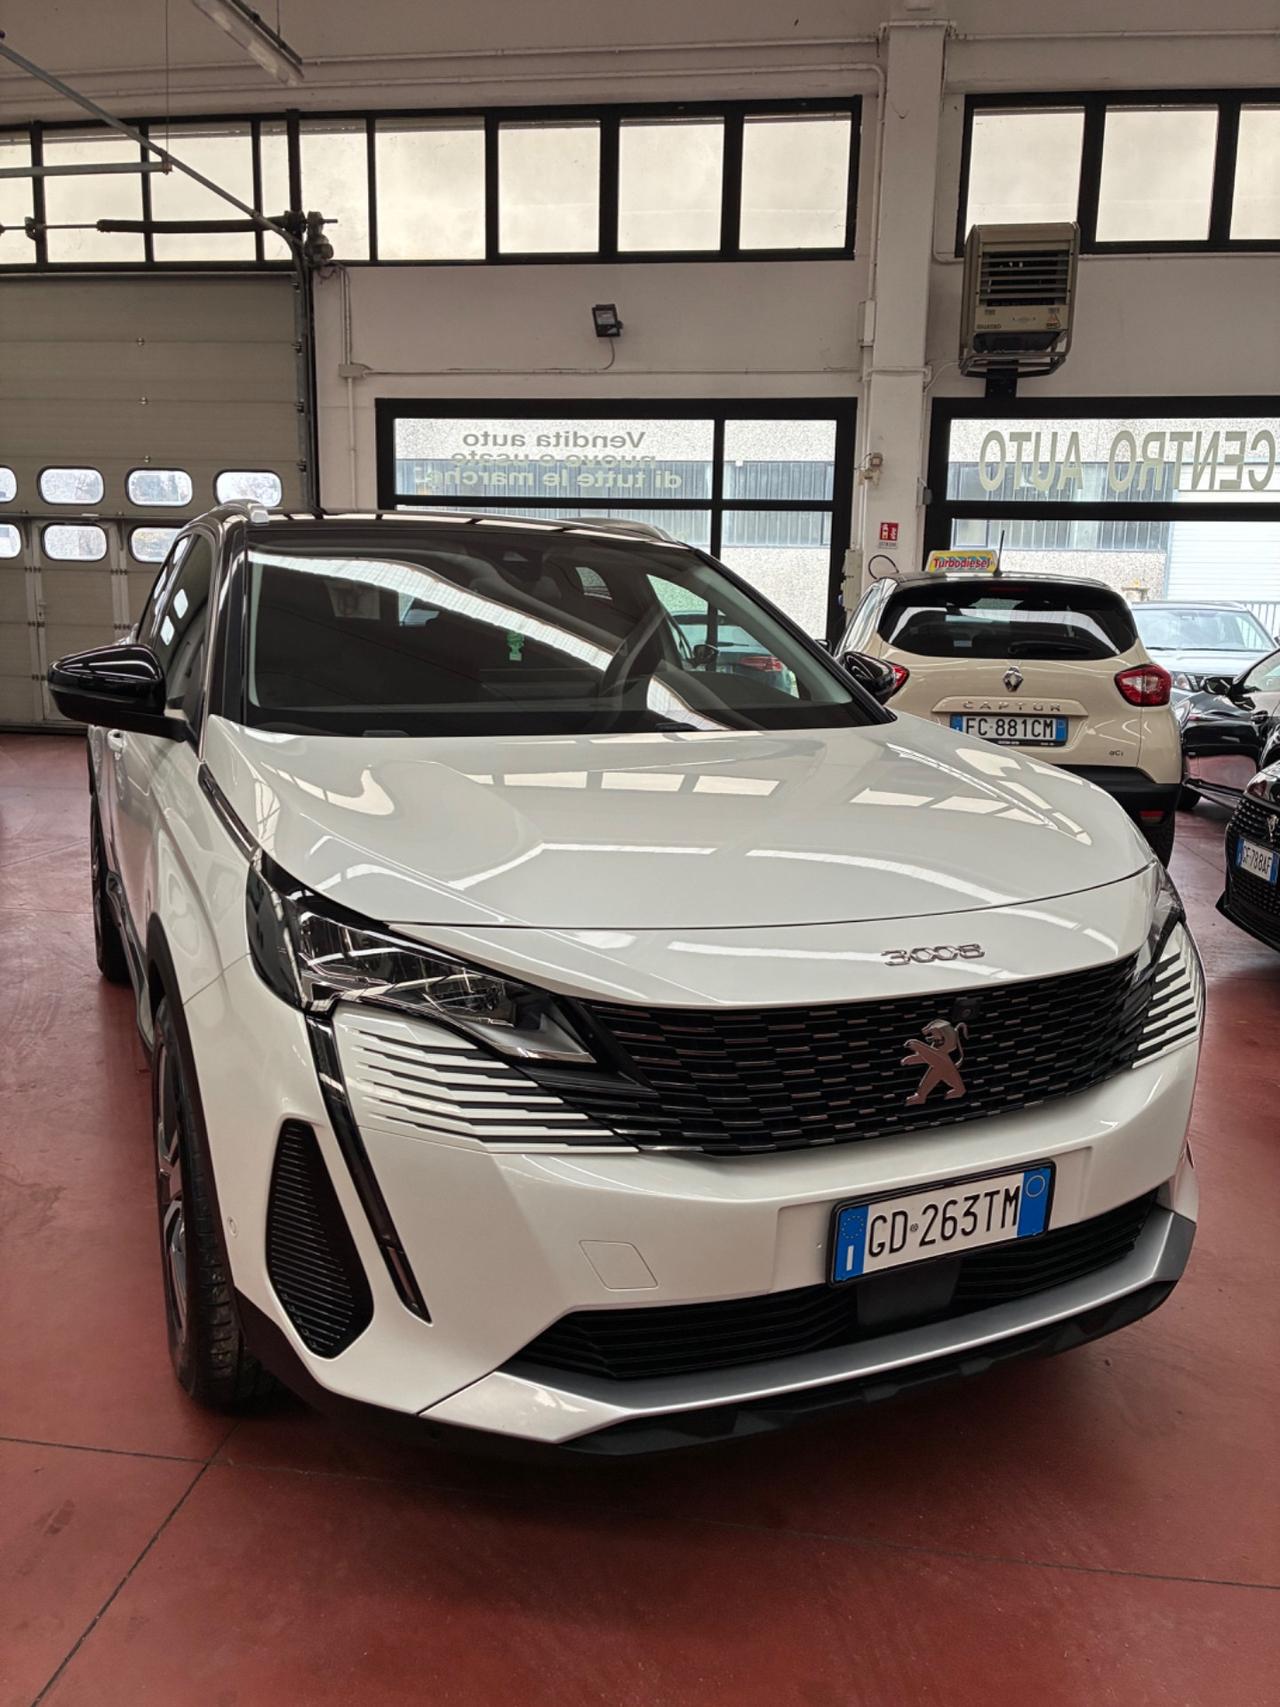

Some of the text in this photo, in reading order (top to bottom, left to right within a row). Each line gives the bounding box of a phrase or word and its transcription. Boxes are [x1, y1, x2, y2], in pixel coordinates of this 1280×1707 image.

[963, 701, 1061, 712] CAPTUR
[995, 718, 1054, 738] 881CM
[881, 943, 985, 966] 3008
[868, 1185, 1021, 1257] GD 263TM
